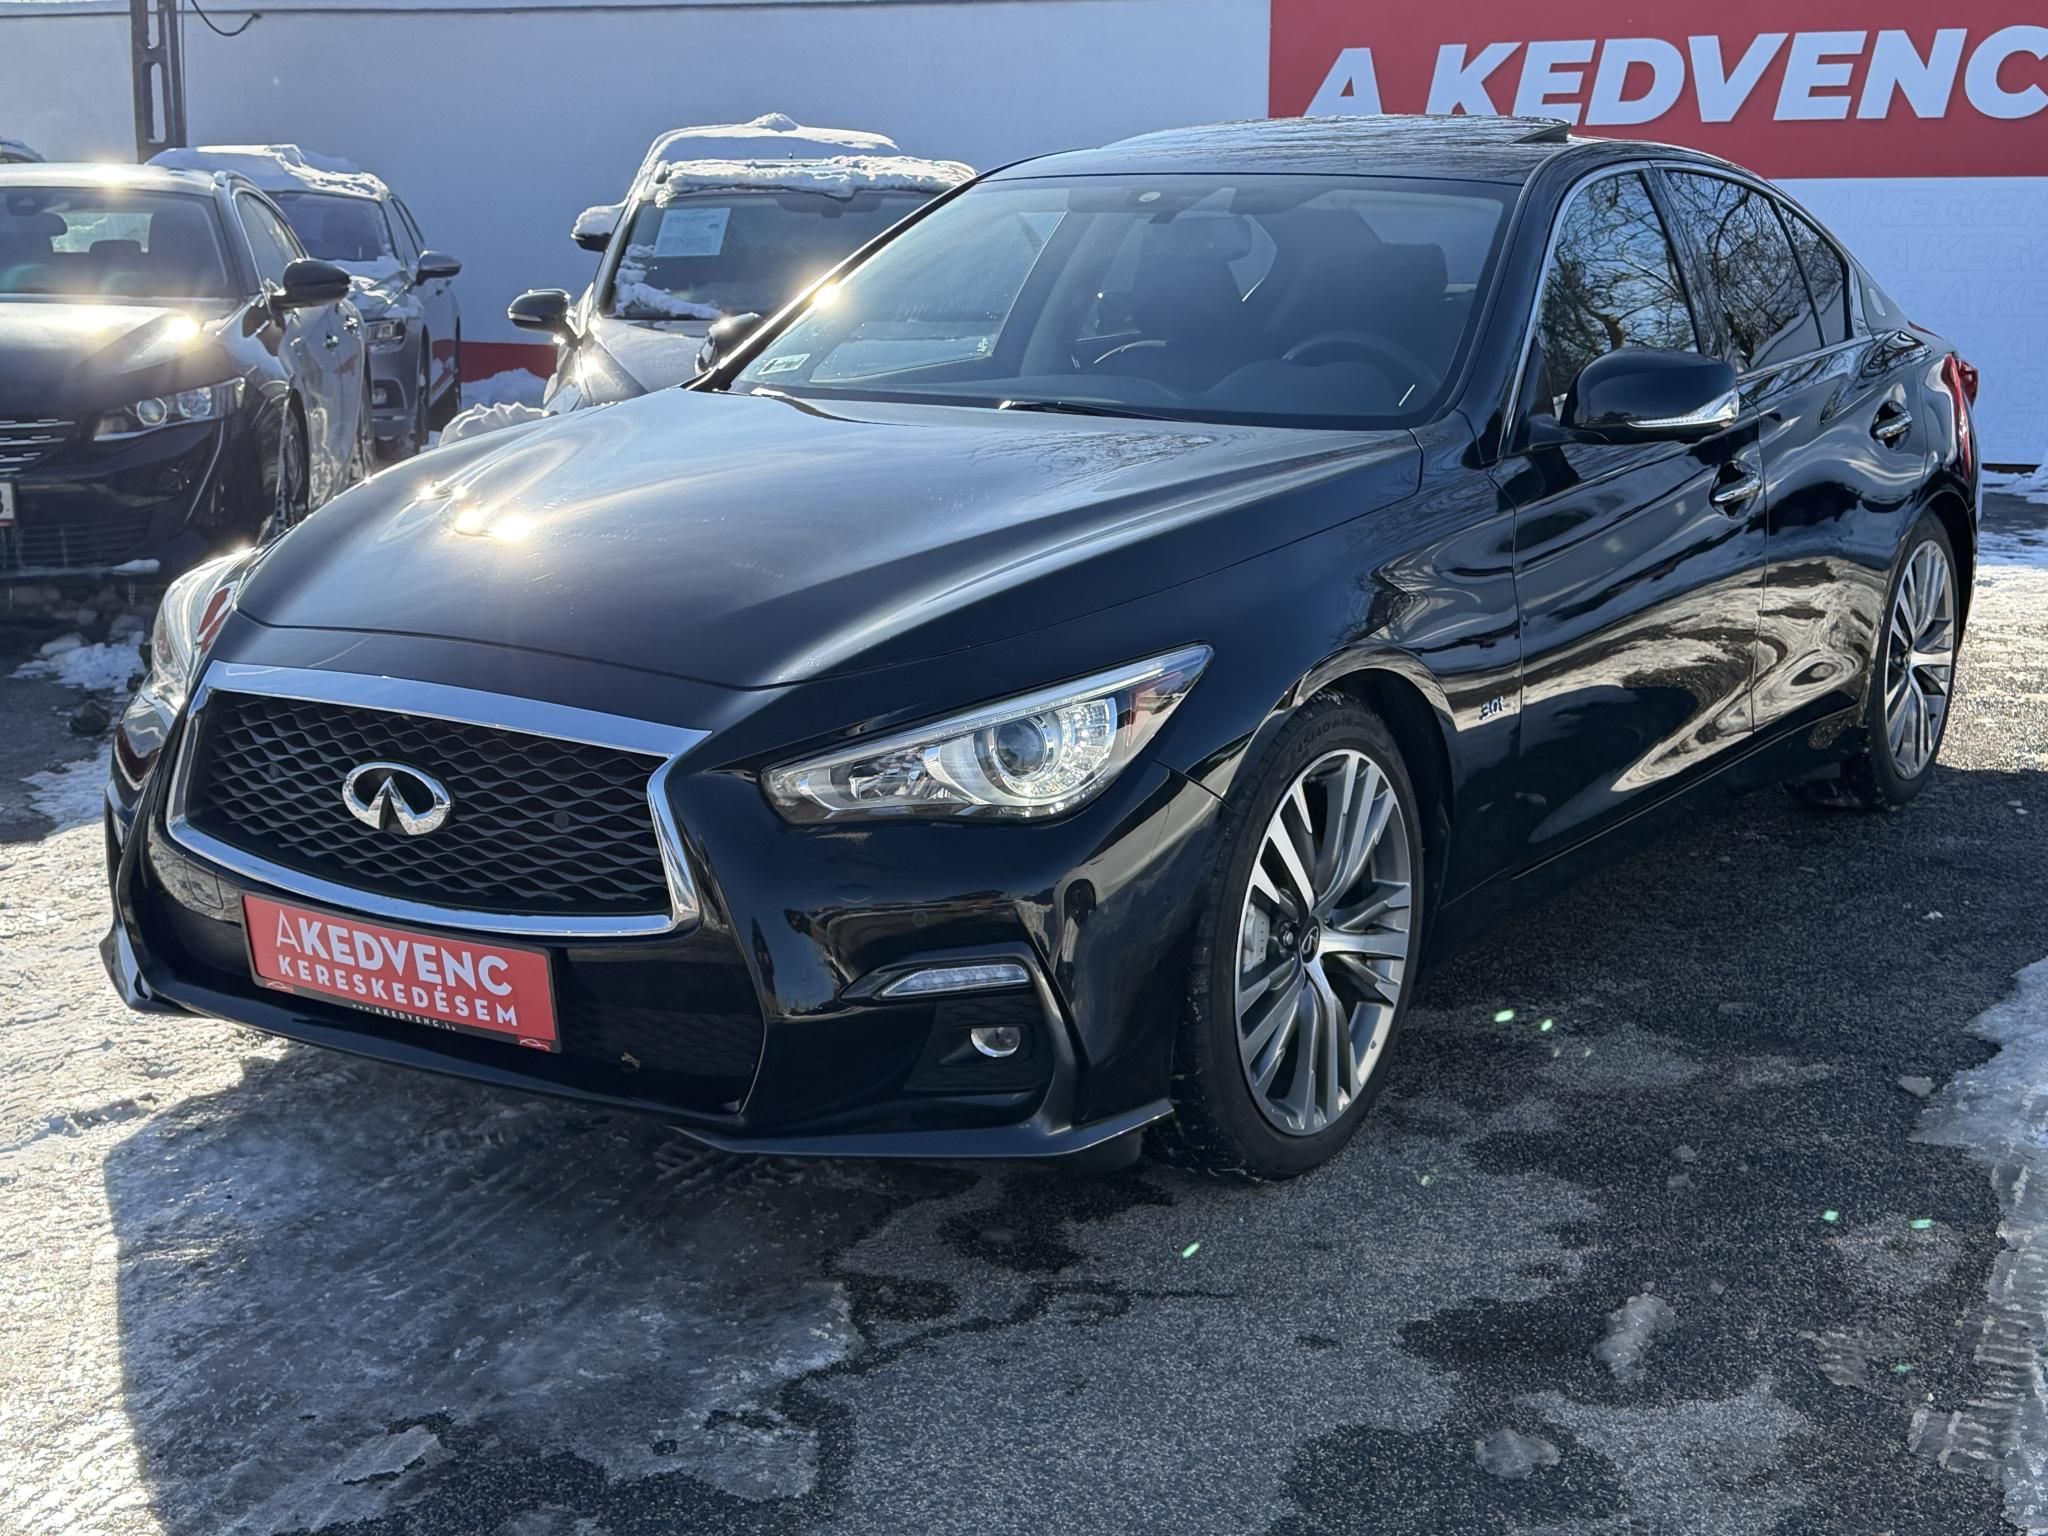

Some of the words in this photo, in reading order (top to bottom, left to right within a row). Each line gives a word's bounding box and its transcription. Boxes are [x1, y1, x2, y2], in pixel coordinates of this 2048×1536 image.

[1305, 47, 1383, 117] A
[1426, 25, 2048, 126] KEDVENC
[278, 955, 518, 1027] KERESKEDÉSEM
